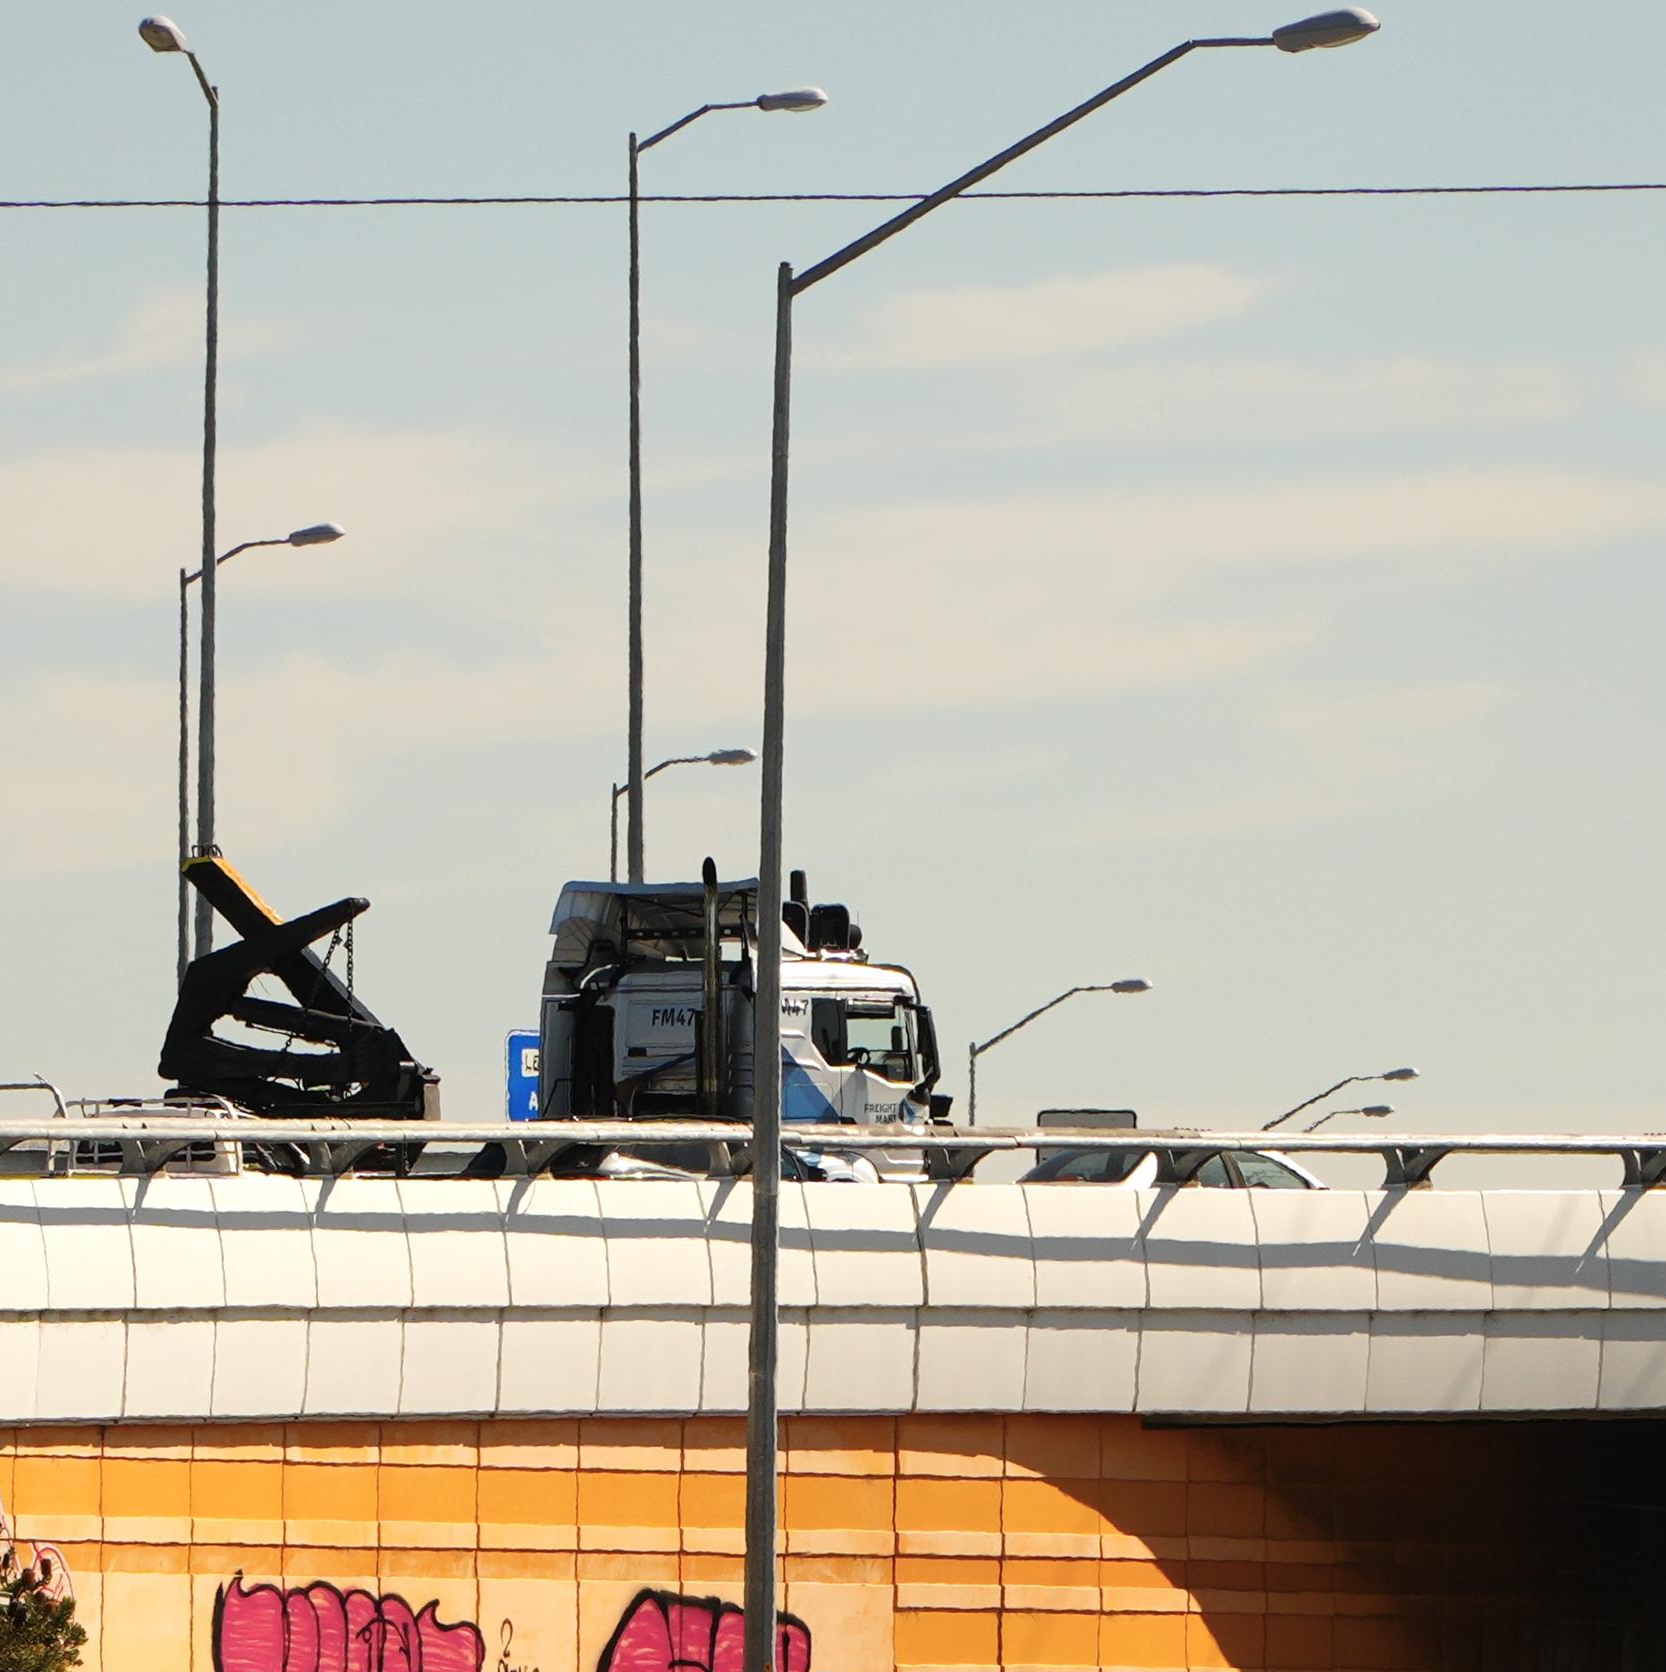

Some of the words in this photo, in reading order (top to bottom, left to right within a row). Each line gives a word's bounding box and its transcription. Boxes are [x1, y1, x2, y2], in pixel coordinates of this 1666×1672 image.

[652, 1008, 696, 1027] FM47
[864, 1103, 898, 1114] FREIGHT
[876, 1114, 897, 1124] MART
